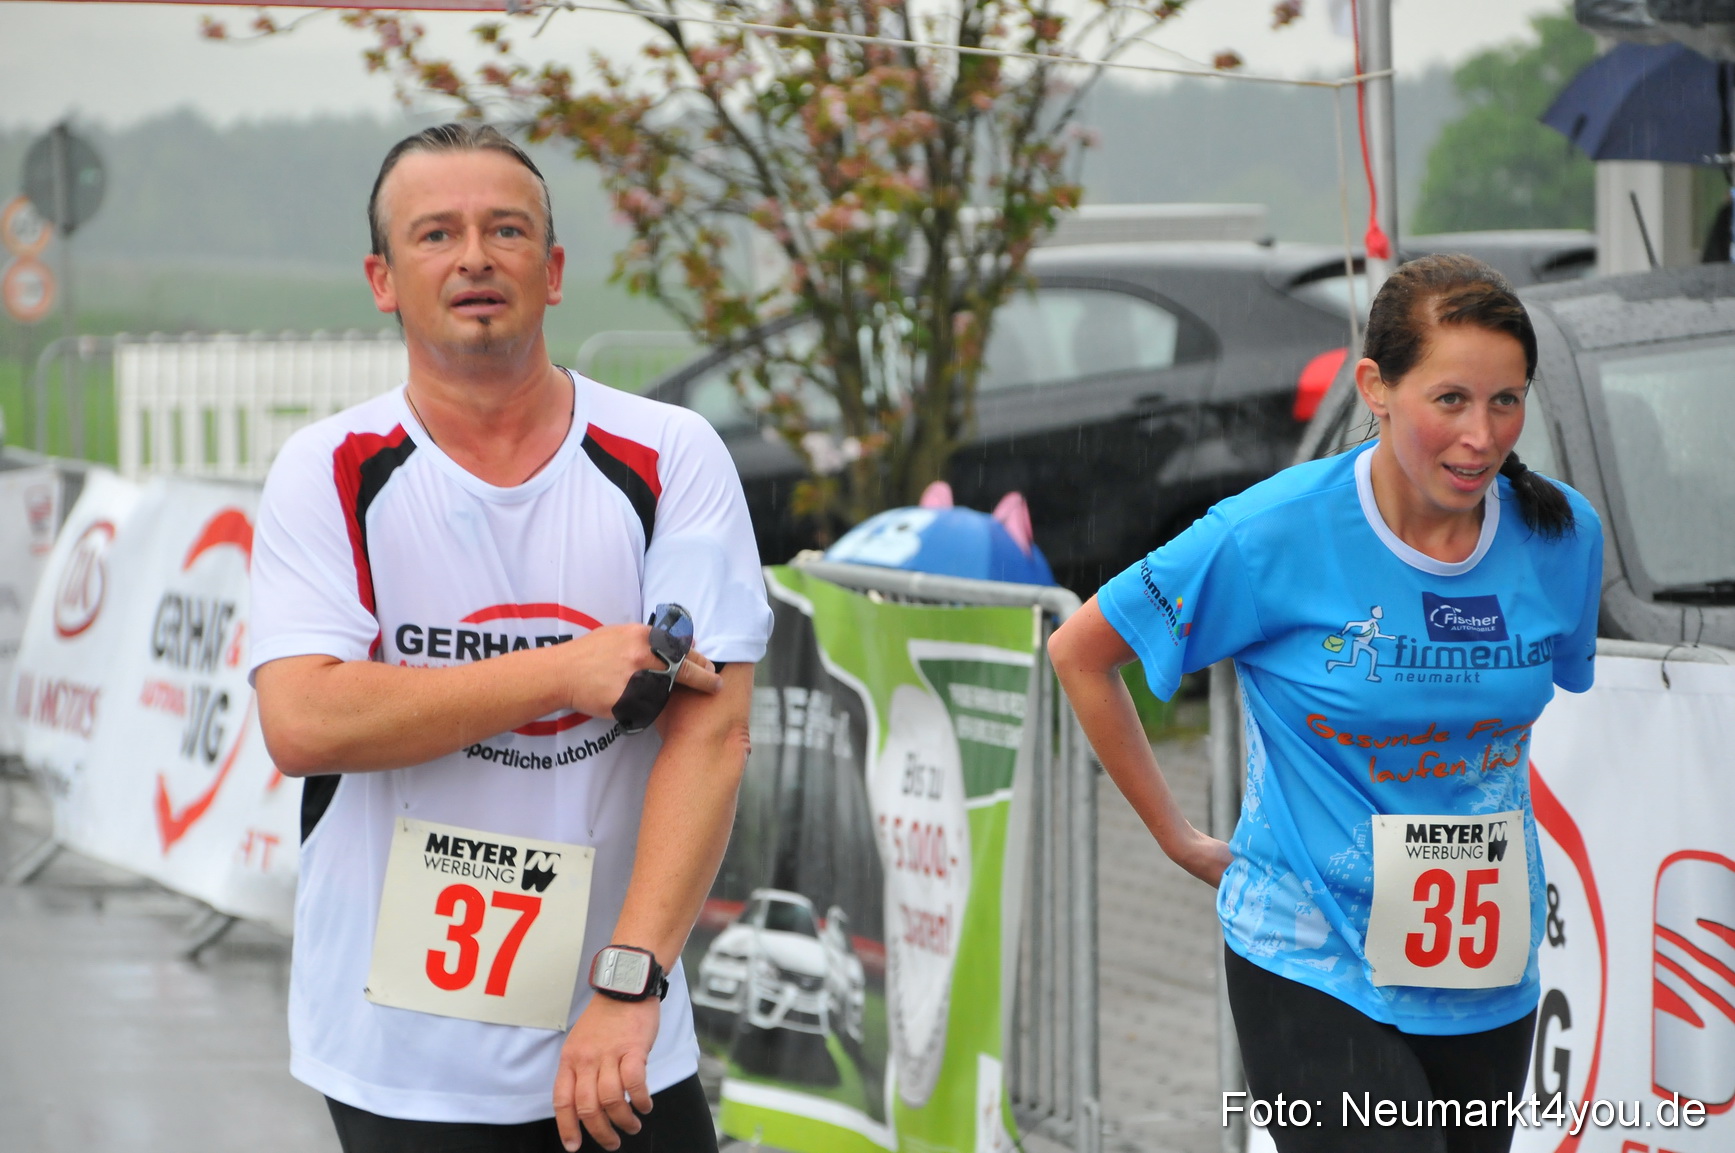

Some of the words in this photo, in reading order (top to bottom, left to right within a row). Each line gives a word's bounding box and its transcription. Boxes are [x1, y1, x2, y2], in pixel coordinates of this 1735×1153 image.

[1140, 556, 1177, 628] schmann
[1444, 612, 1499, 627] Fischer
[1395, 633, 1554, 669] firmenlau
[1394, 671, 1481, 684] neumarkt
[555, 722, 622, 767] utohaus
[1306, 713, 1450, 749] Gesunde
[1369, 750, 1466, 784] laufen
[425, 832, 518, 867] MEYER
[1405, 823, 1484, 844] MEYER
[424, 854, 515, 884] WERBUNG
[1405, 845, 1484, 860] WERBUNG
[1405, 868, 1501, 969] 35
[425, 883, 542, 998] 37
